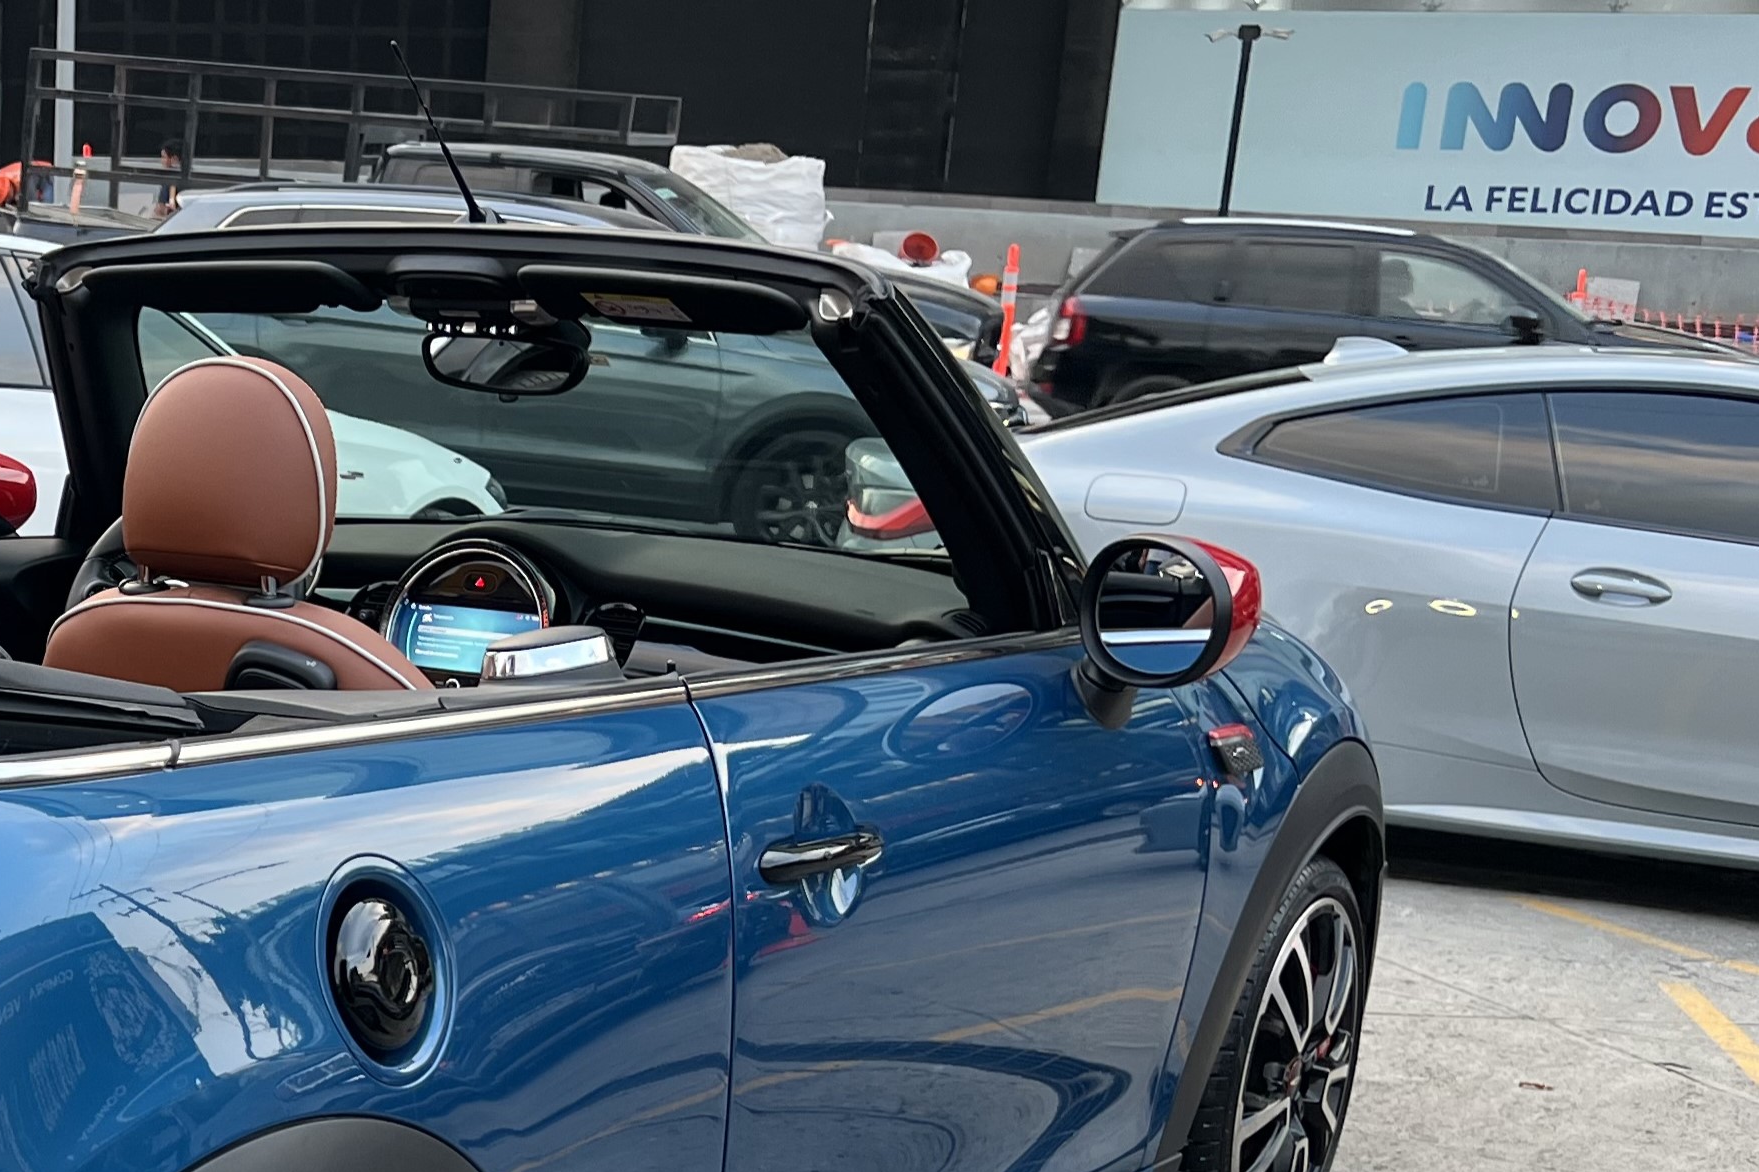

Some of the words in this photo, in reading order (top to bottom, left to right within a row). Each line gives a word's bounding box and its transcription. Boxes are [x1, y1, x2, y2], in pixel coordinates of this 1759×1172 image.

[1424, 184, 1473, 212] LA
[1485, 185, 1693, 217] FELICIDAD
[1704, 191, 1759, 219] ES
